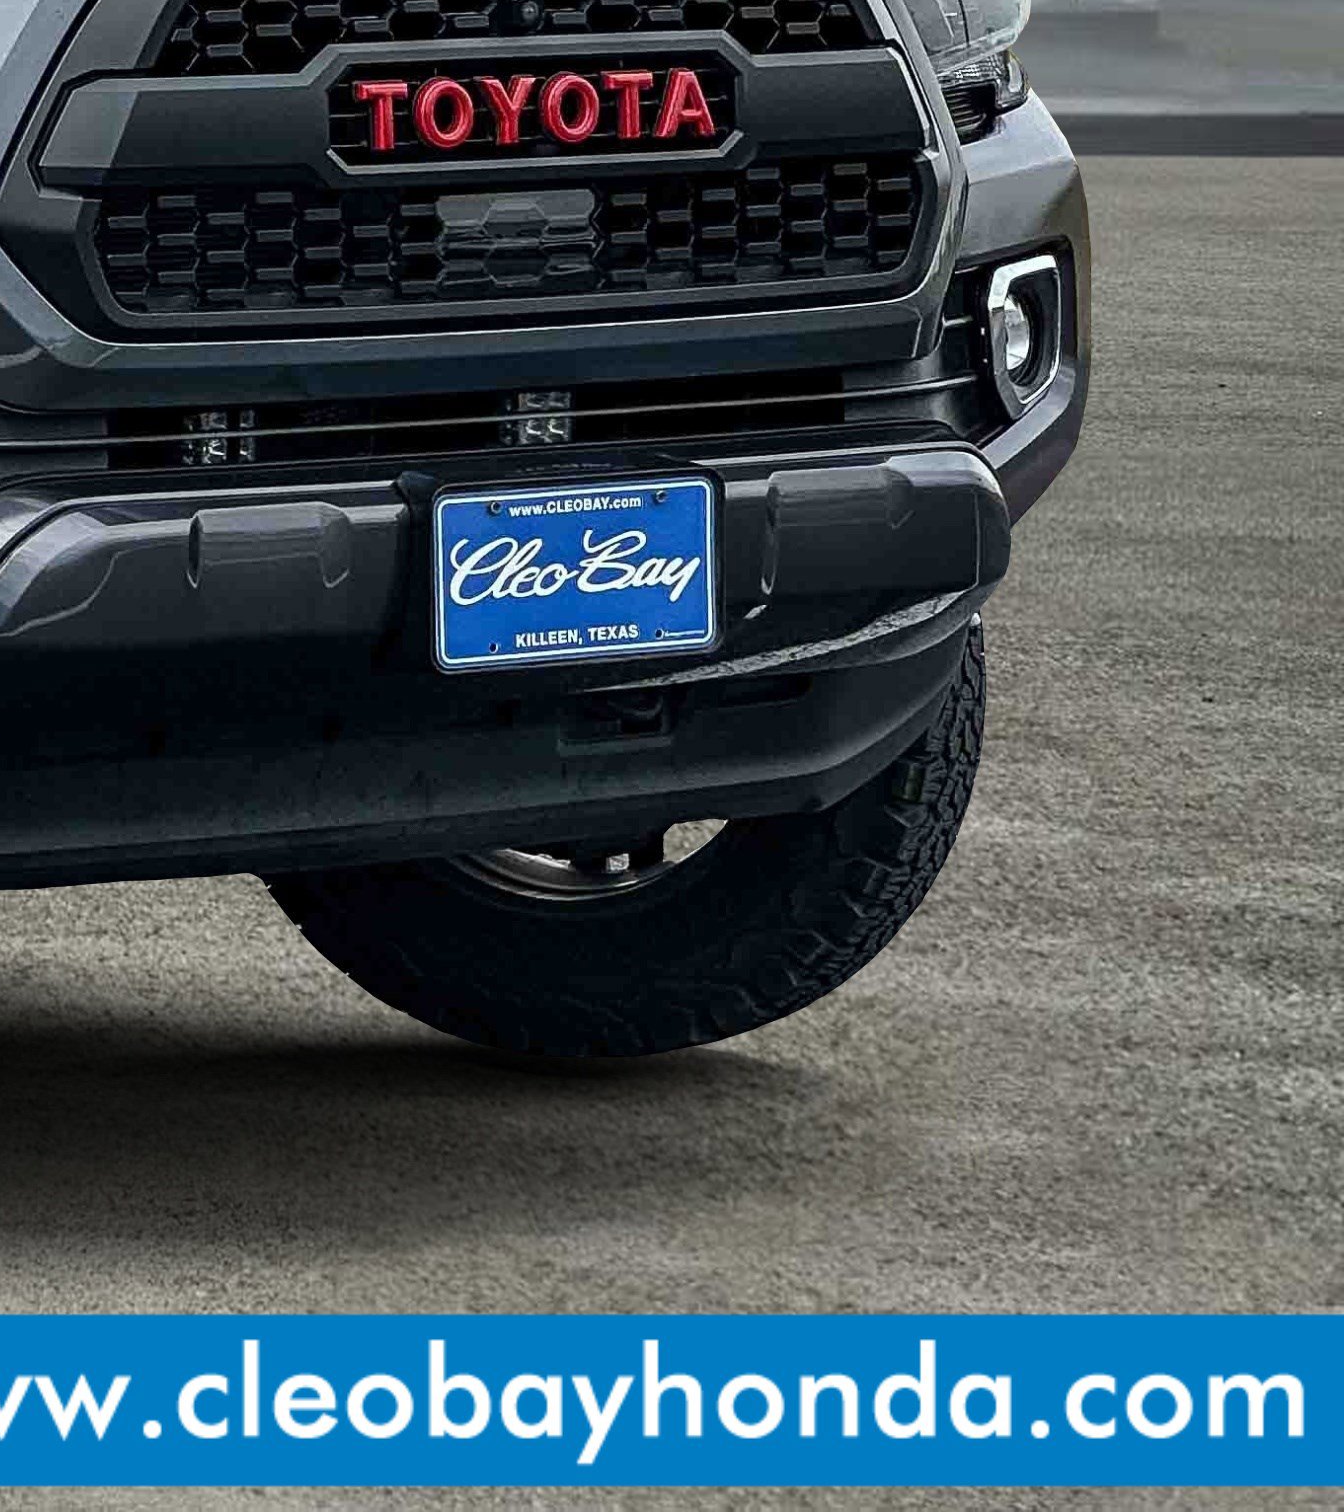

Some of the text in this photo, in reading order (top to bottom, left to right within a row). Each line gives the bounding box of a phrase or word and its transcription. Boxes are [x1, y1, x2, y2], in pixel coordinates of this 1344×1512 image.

[355, 67, 715, 152] TOYOTA
[508, 495, 642, 517] www.CLEOBAY.com
[450, 529, 701, 606] Cleo Bay
[515, 623, 639, 649] KILLEEN, TEXAS
